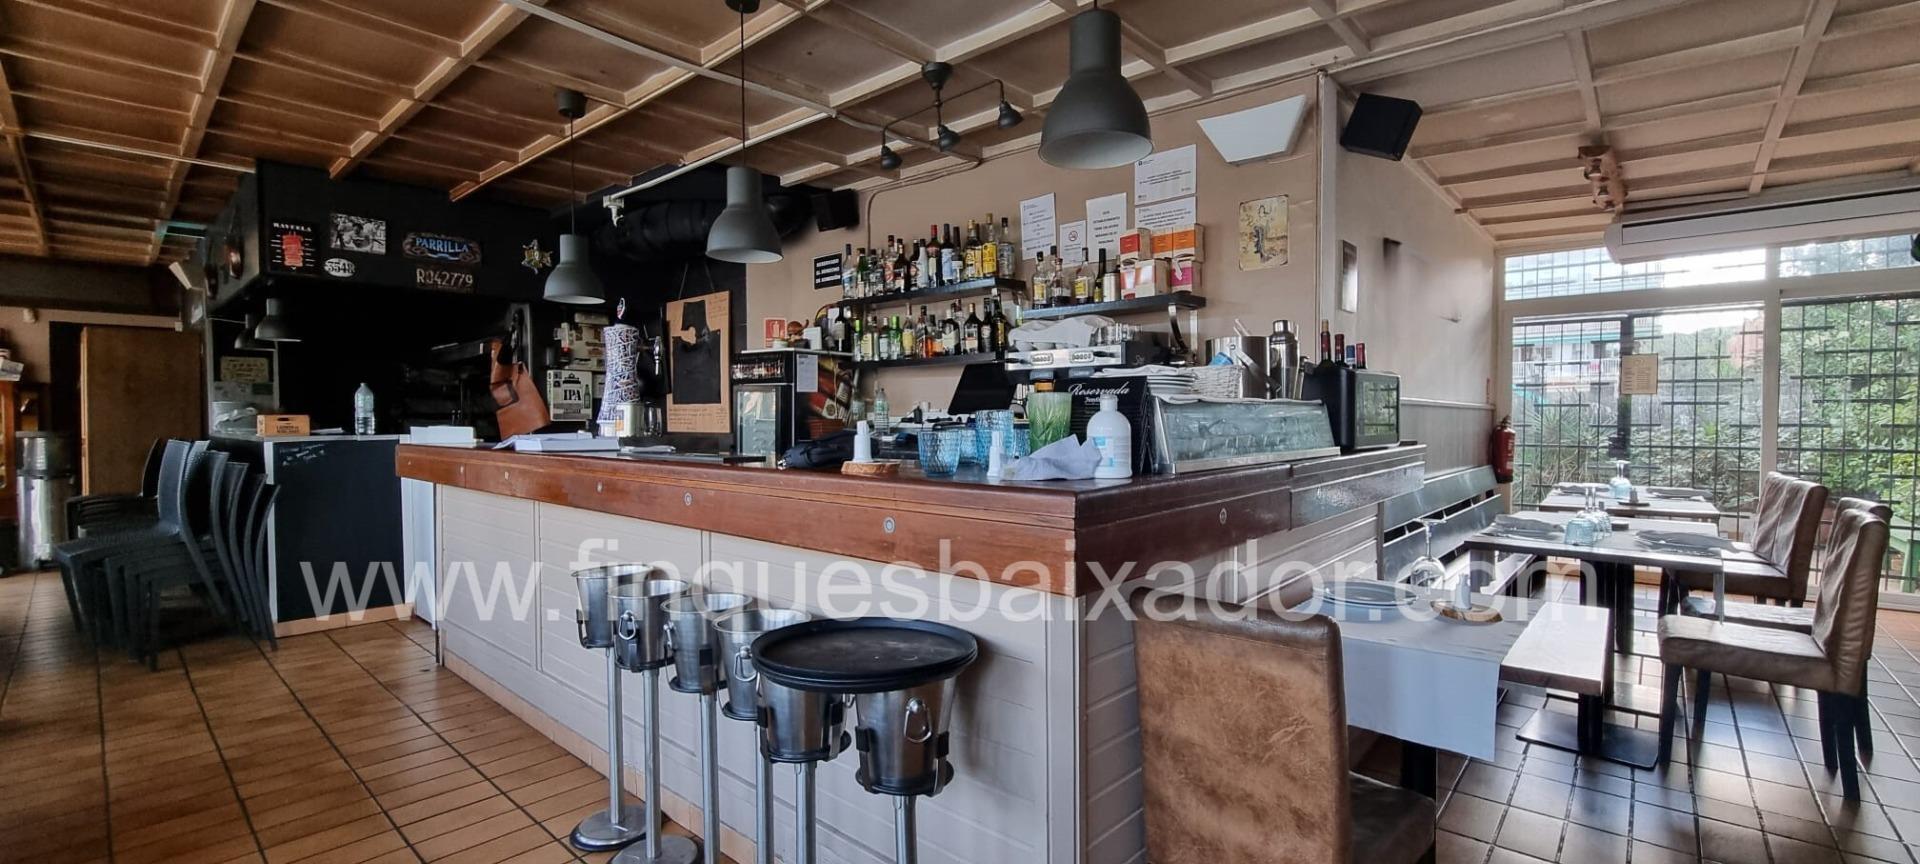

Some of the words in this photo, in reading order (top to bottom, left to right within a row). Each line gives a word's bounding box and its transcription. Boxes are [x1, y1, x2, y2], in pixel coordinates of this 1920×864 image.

[415, 237, 469, 253] PARRILLA
[563, 389, 581, 401] IPA
[1067, 381, 1130, 396] Reservada
